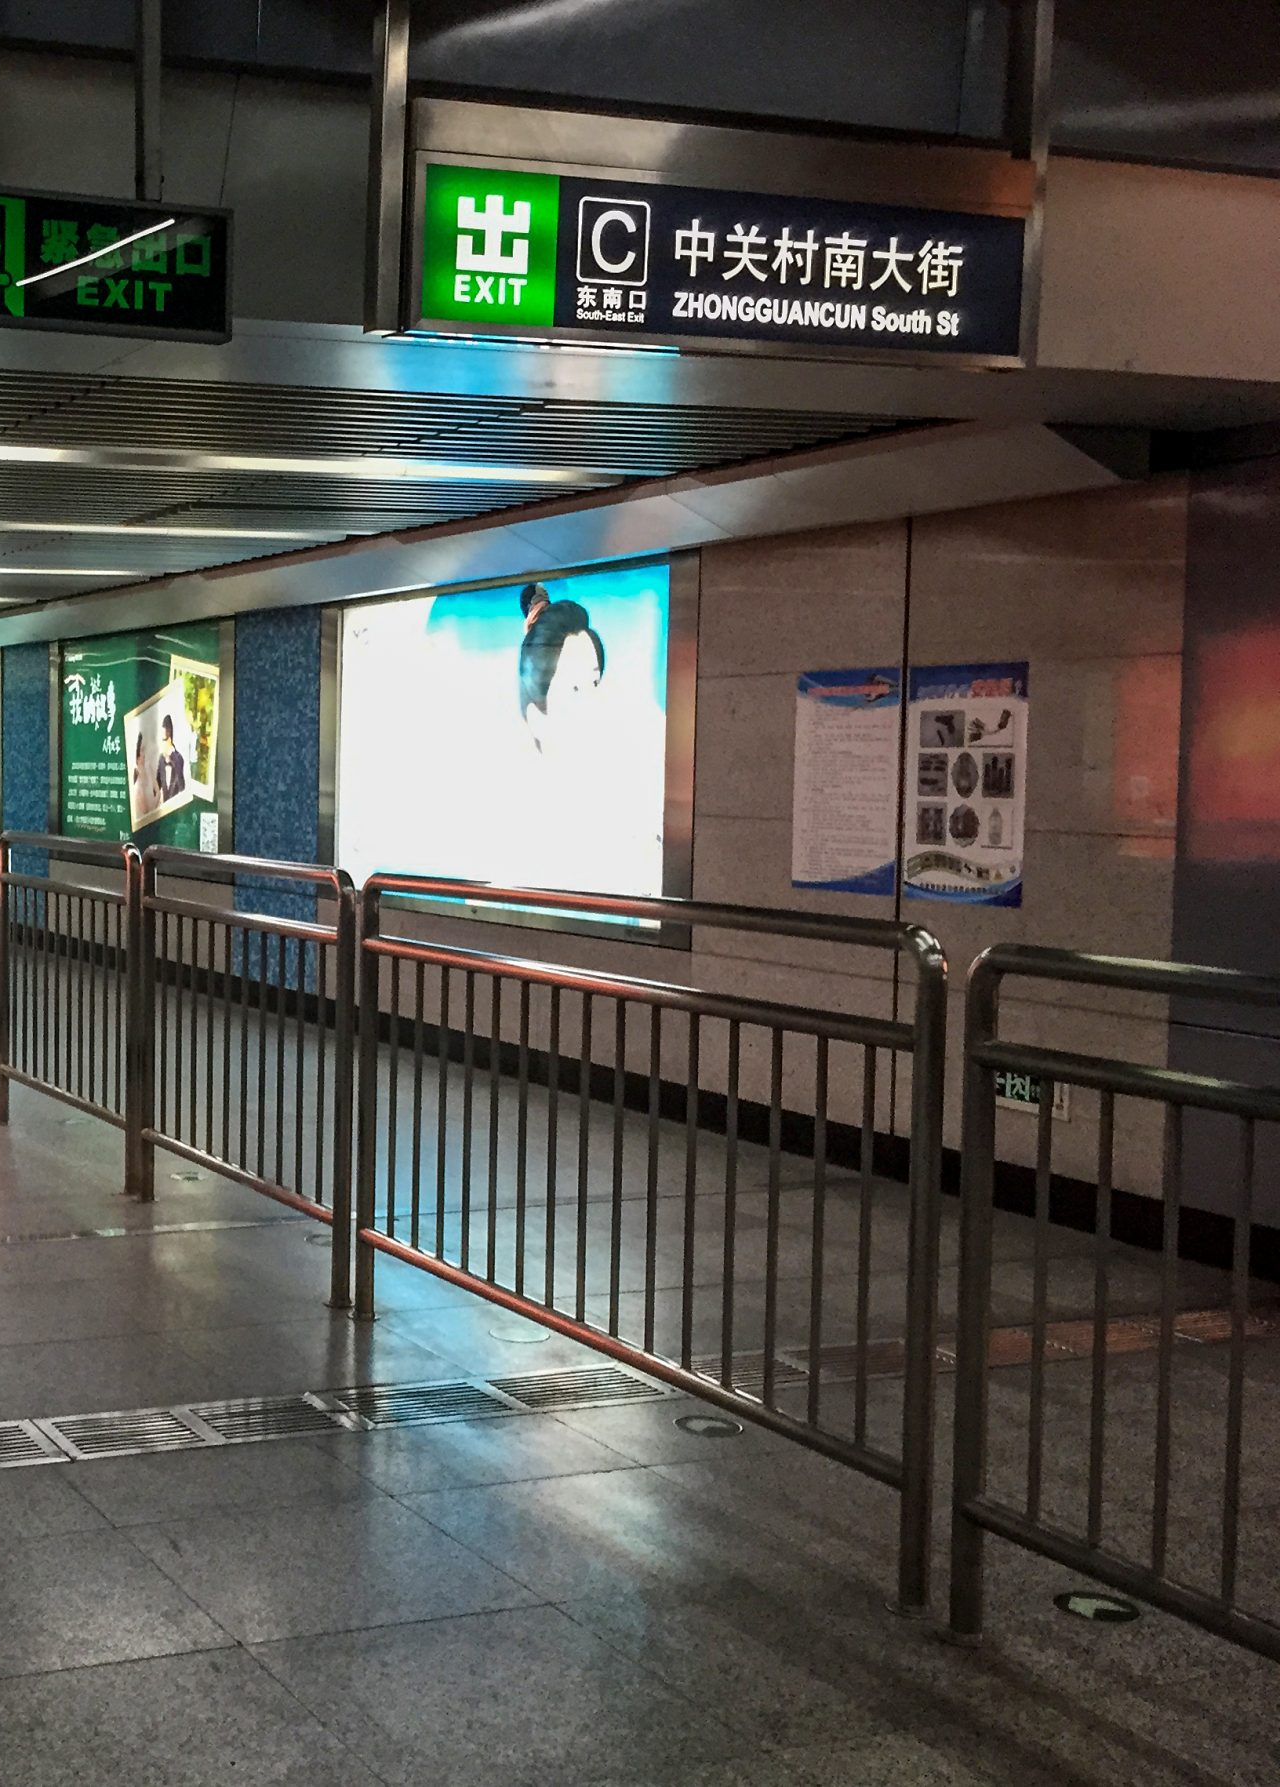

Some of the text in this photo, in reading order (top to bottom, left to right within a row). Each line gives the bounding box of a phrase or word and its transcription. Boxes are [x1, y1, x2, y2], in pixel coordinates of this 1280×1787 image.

[40, 219, 211, 277] 紧急出口
[591, 210, 636, 273] C
[674, 218, 964, 297] 中关村南大街
[77, 275, 173, 312] EXIT
[454, 274, 528, 306] EXIT
[576, 285, 647, 310] 东南口
[576, 308, 645, 324] South-East Exit
[672, 291, 960, 336] ZHONGGUANCUN South St
